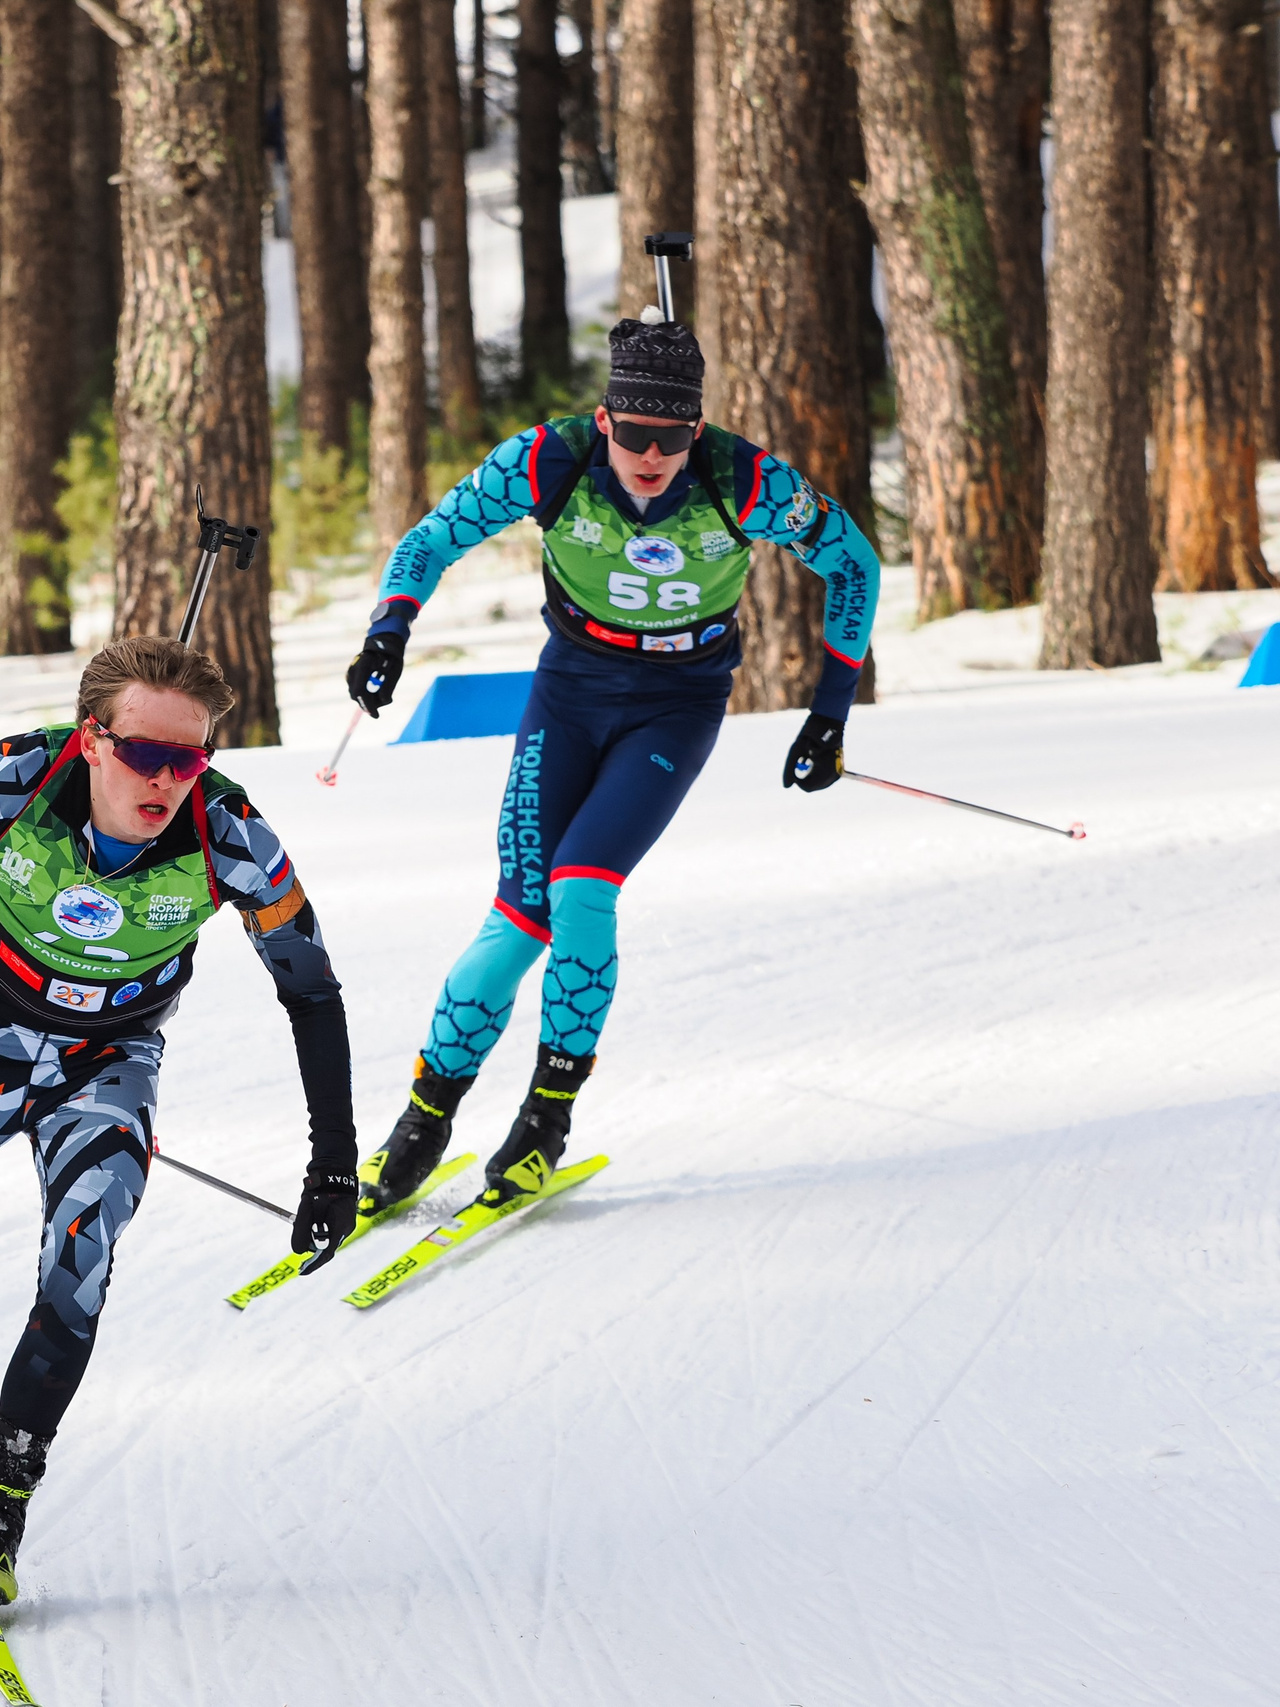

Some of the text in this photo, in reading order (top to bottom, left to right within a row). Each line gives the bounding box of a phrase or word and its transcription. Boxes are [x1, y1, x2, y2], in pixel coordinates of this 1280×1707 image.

[608, 570, 701, 611] 58
[498, 754, 522, 879] ОБЛАСТЬ
[517, 728, 545, 906] ТЮМЕНСКАЯ
[148, 903, 191, 913] НОРМА
[150, 894, 186, 905] СПОРТ
[147, 911, 189, 921] ЖИЗНИ
[548, 1055, 575, 1072] 208
[327, 1174, 356, 1189] MOAX
[243, 1261, 296, 1298] FISCHER
[362, 1256, 418, 1296] FISCHER
